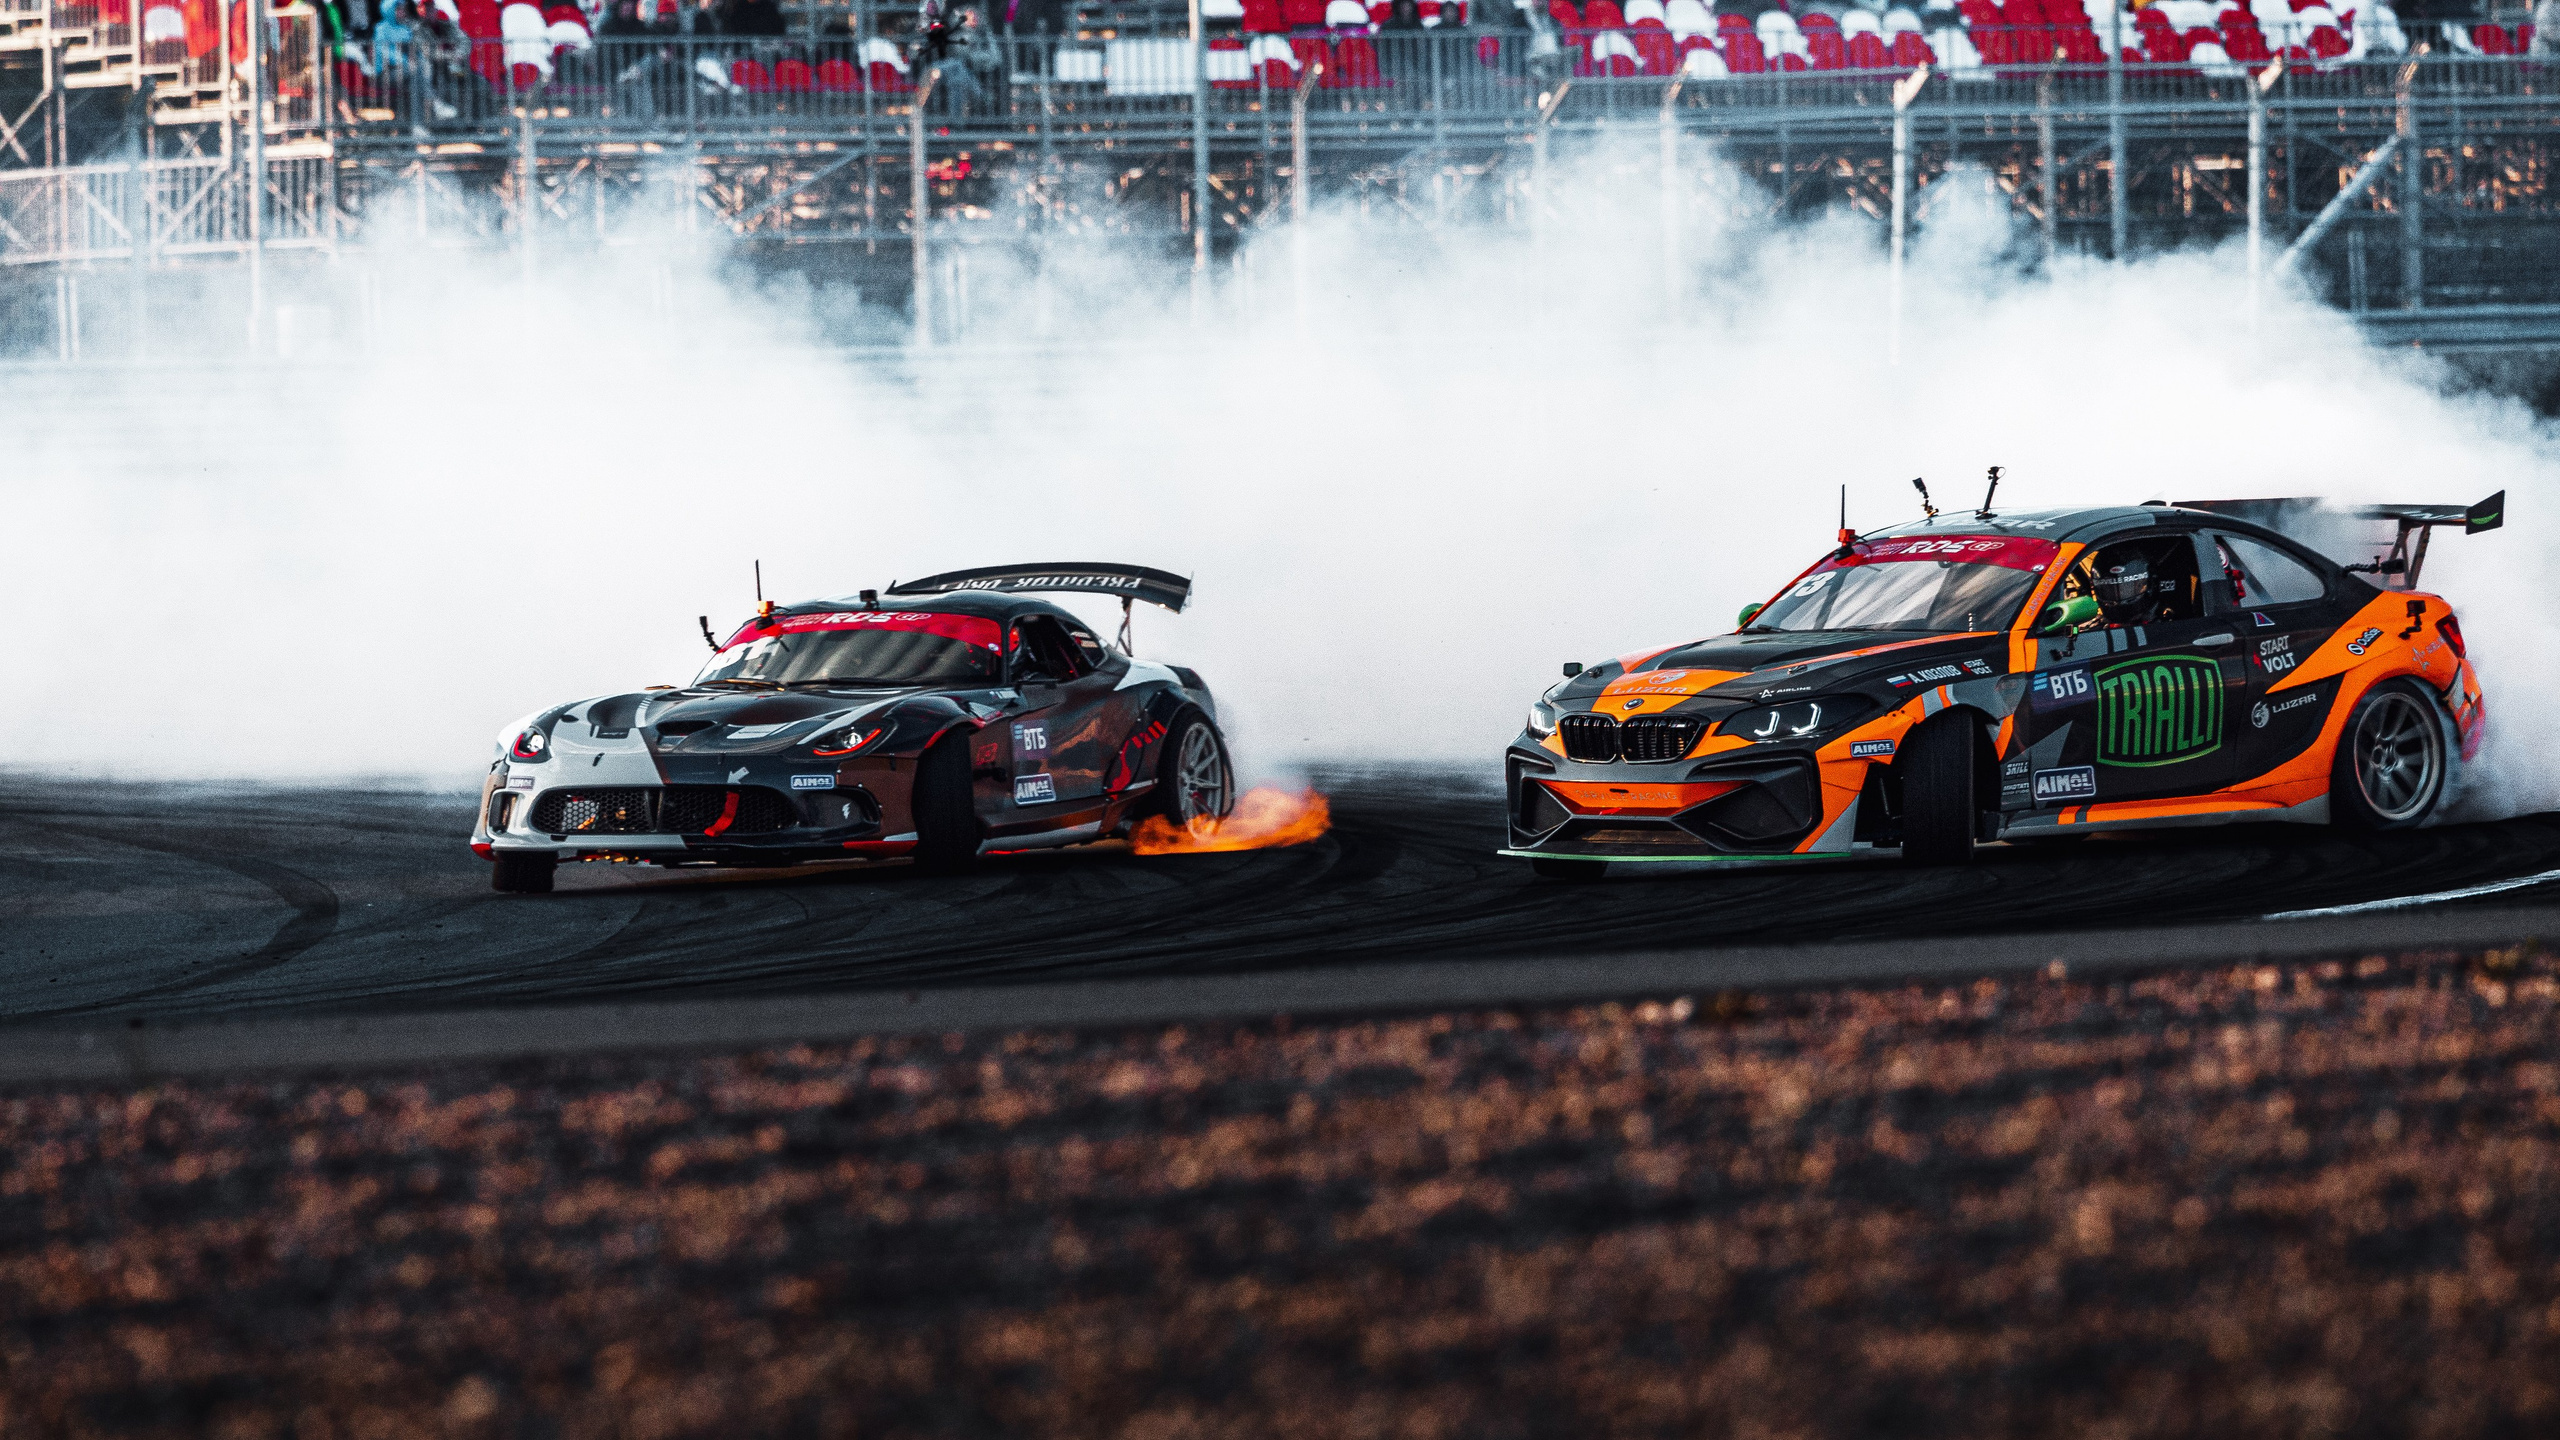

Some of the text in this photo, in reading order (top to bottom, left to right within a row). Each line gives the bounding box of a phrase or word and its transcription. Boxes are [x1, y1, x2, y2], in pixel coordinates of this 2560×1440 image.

[1900, 540, 1977, 554] RDS
[822, 611, 898, 624] RDS
[2260, 635, 2290, 656] START
[1971, 665, 1992, 675] VOLT
[2263, 652, 2296, 673] VOLT
[1613, 686, 1688, 694] LUZAR
[2050, 669, 2088, 699] ВТБ
[2102, 665, 2215, 755] TRIALLI
[2272, 693, 2317, 714] LUZAR
[1023, 727, 1047, 750] ВТБ
[1853, 743, 1893, 754] AIMOL
[793, 778, 832, 787] AIMOL
[2037, 773, 2092, 794] AIMOL
